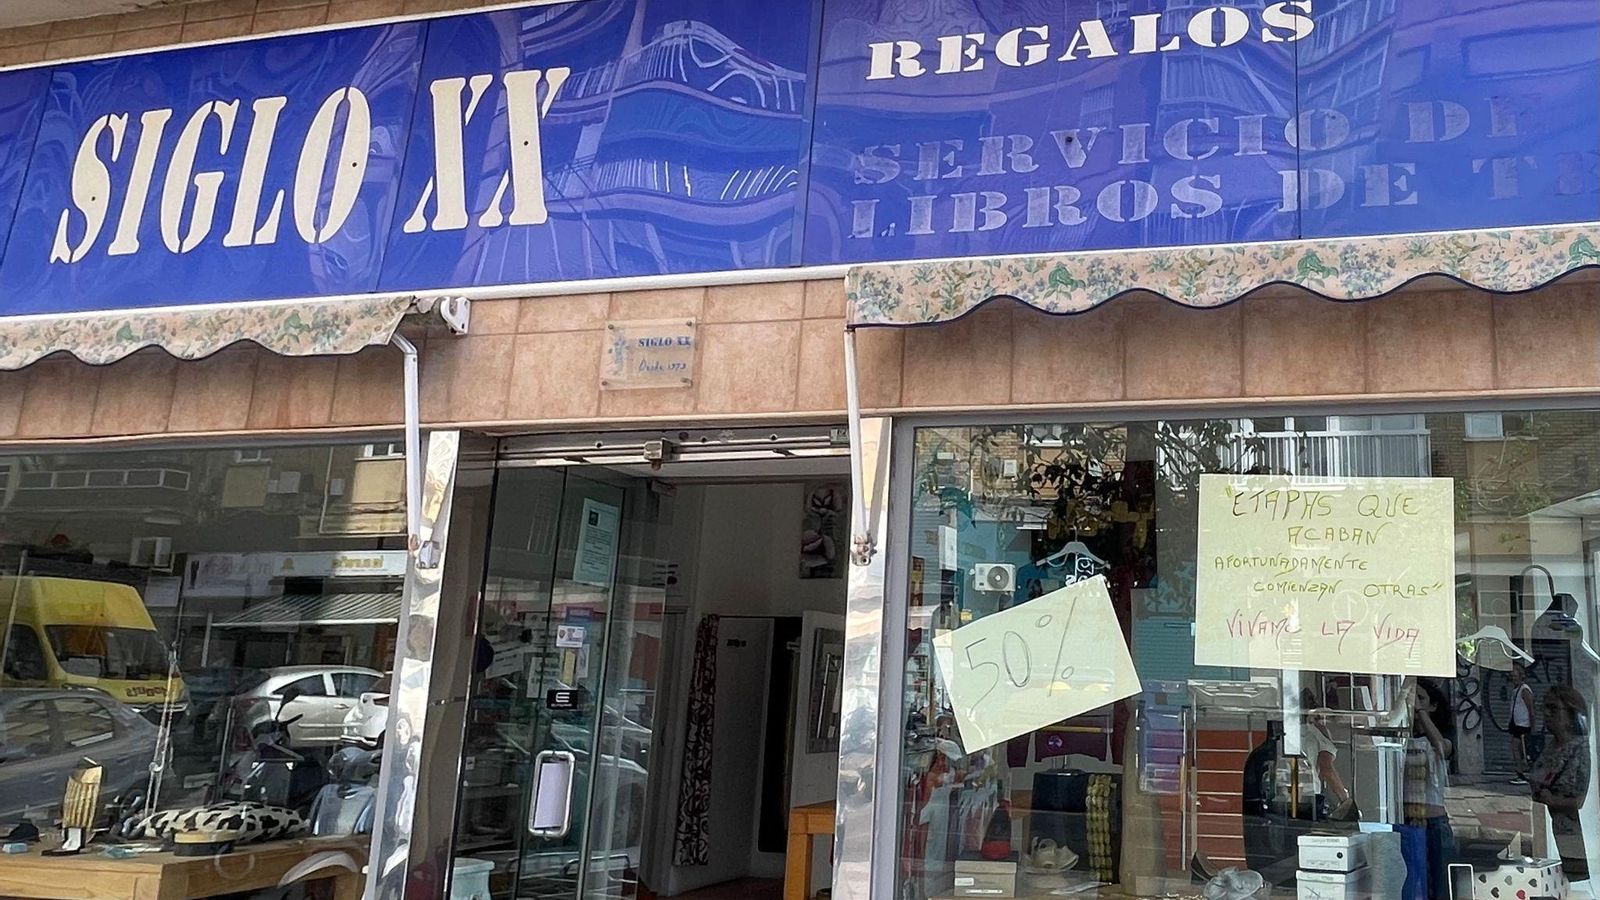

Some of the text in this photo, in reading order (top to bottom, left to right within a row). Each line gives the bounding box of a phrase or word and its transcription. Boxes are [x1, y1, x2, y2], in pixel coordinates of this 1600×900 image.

[865, 1, 1316, 81] REGALOS
[49, 67, 570, 264] SIGLO XX
[854, 108, 1350, 184] SERVICIO
[848, 174, 1223, 239] LIBROS
[1277, 163, 1418, 213] DE
[638, 337, 673, 348] SIGLO
[1288, 522, 1393, 546] ACABAN
[1358, 493, 1419, 519] QUE
[1215, 552, 1369, 577] AFORTUNADAMENTE
[965, 595, 1078, 718] 50%
[1321, 620, 1355, 655] LA
[1372, 613, 1420, 659] VIDA
